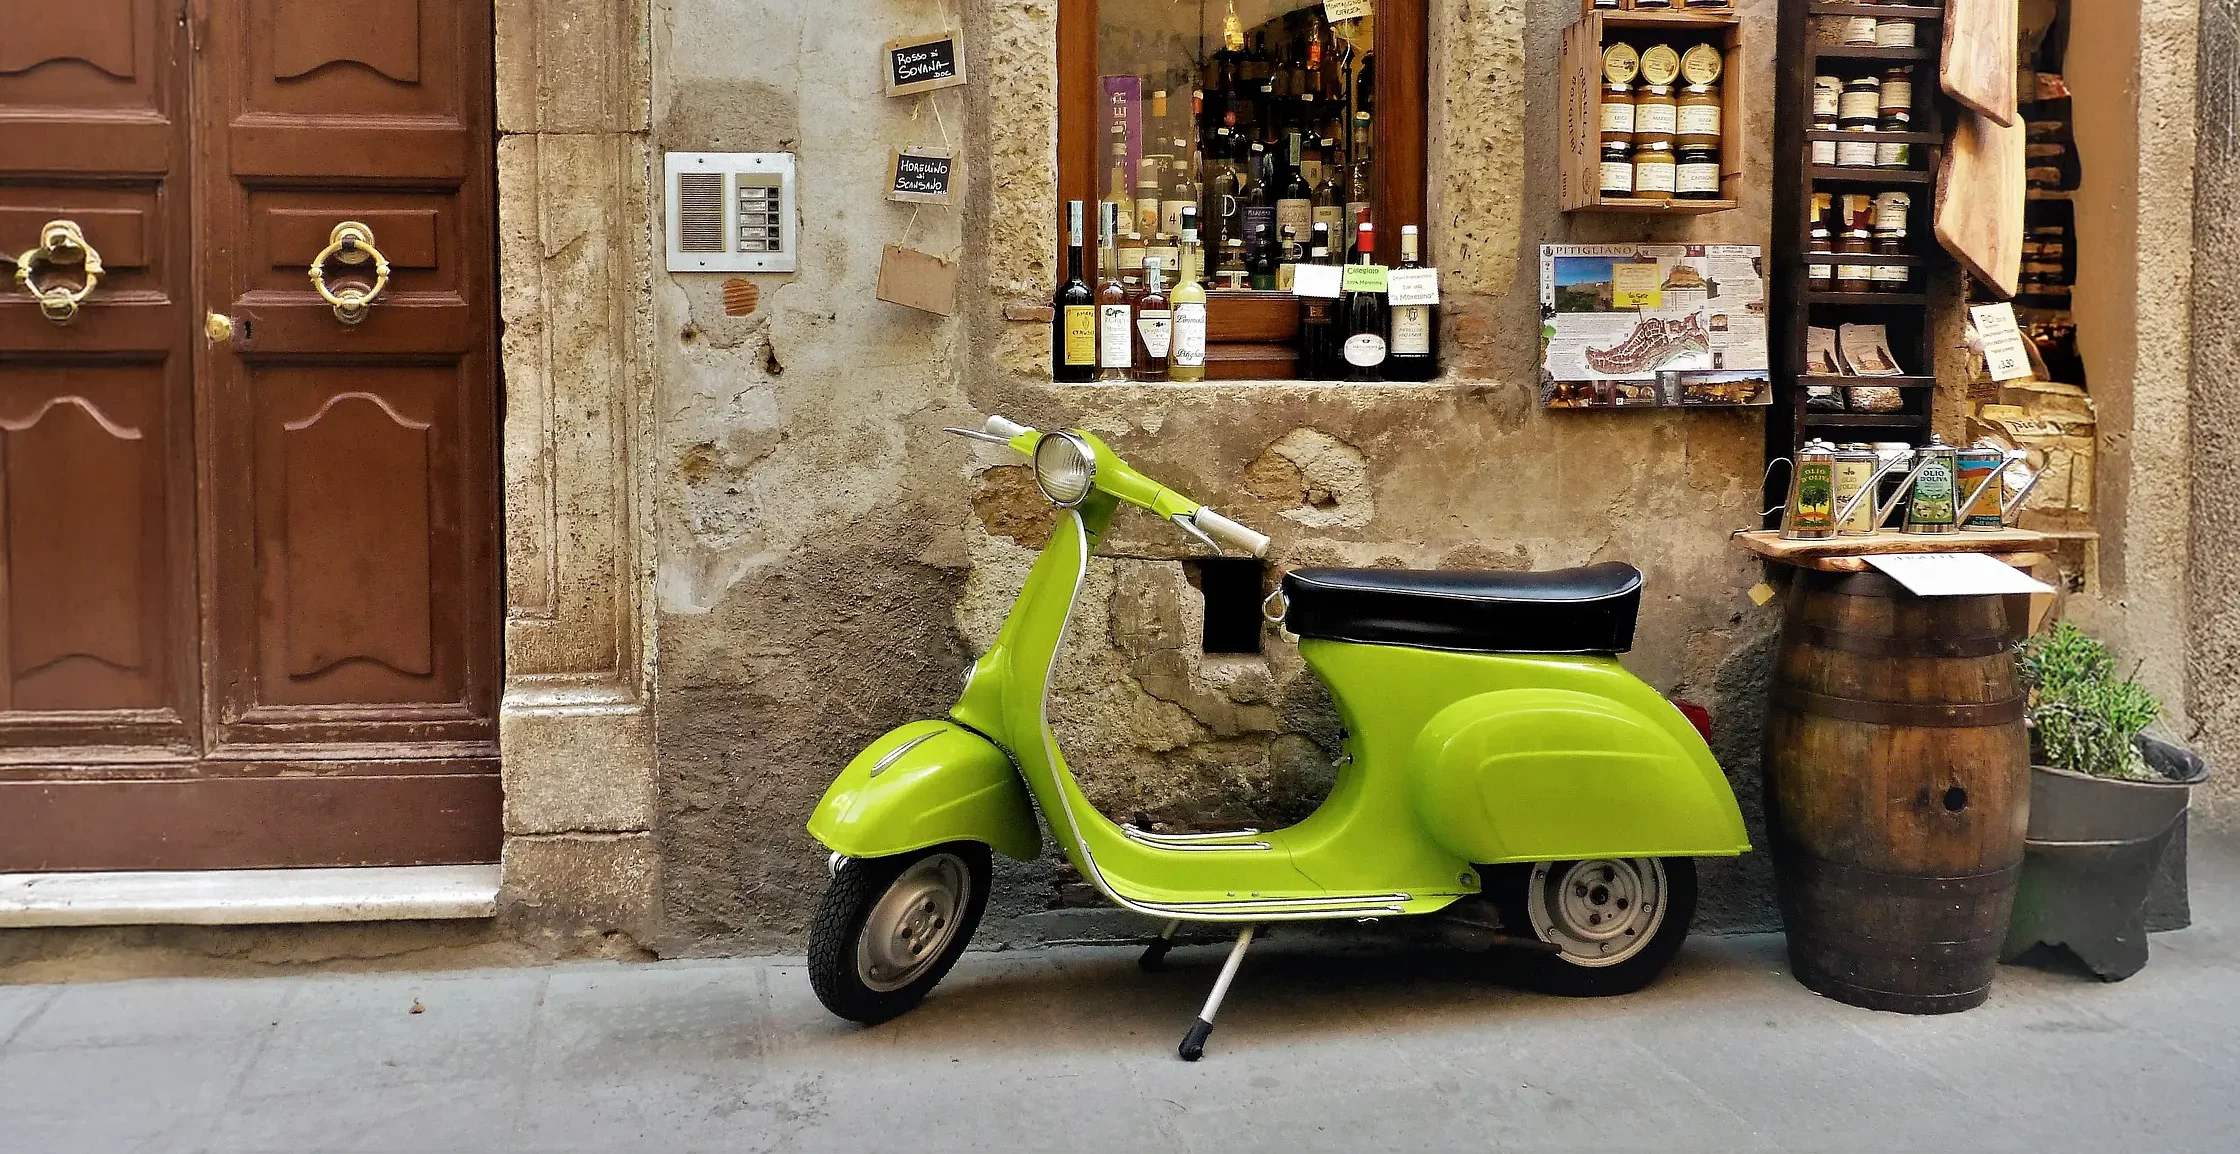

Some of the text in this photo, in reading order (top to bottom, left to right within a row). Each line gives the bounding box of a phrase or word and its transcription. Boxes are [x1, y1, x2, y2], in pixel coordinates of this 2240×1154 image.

[898, 60, 950, 79] SOVANA
[933, 70, 952, 78] DOC
[1556, 247, 1632, 255] PITIGLIANO
